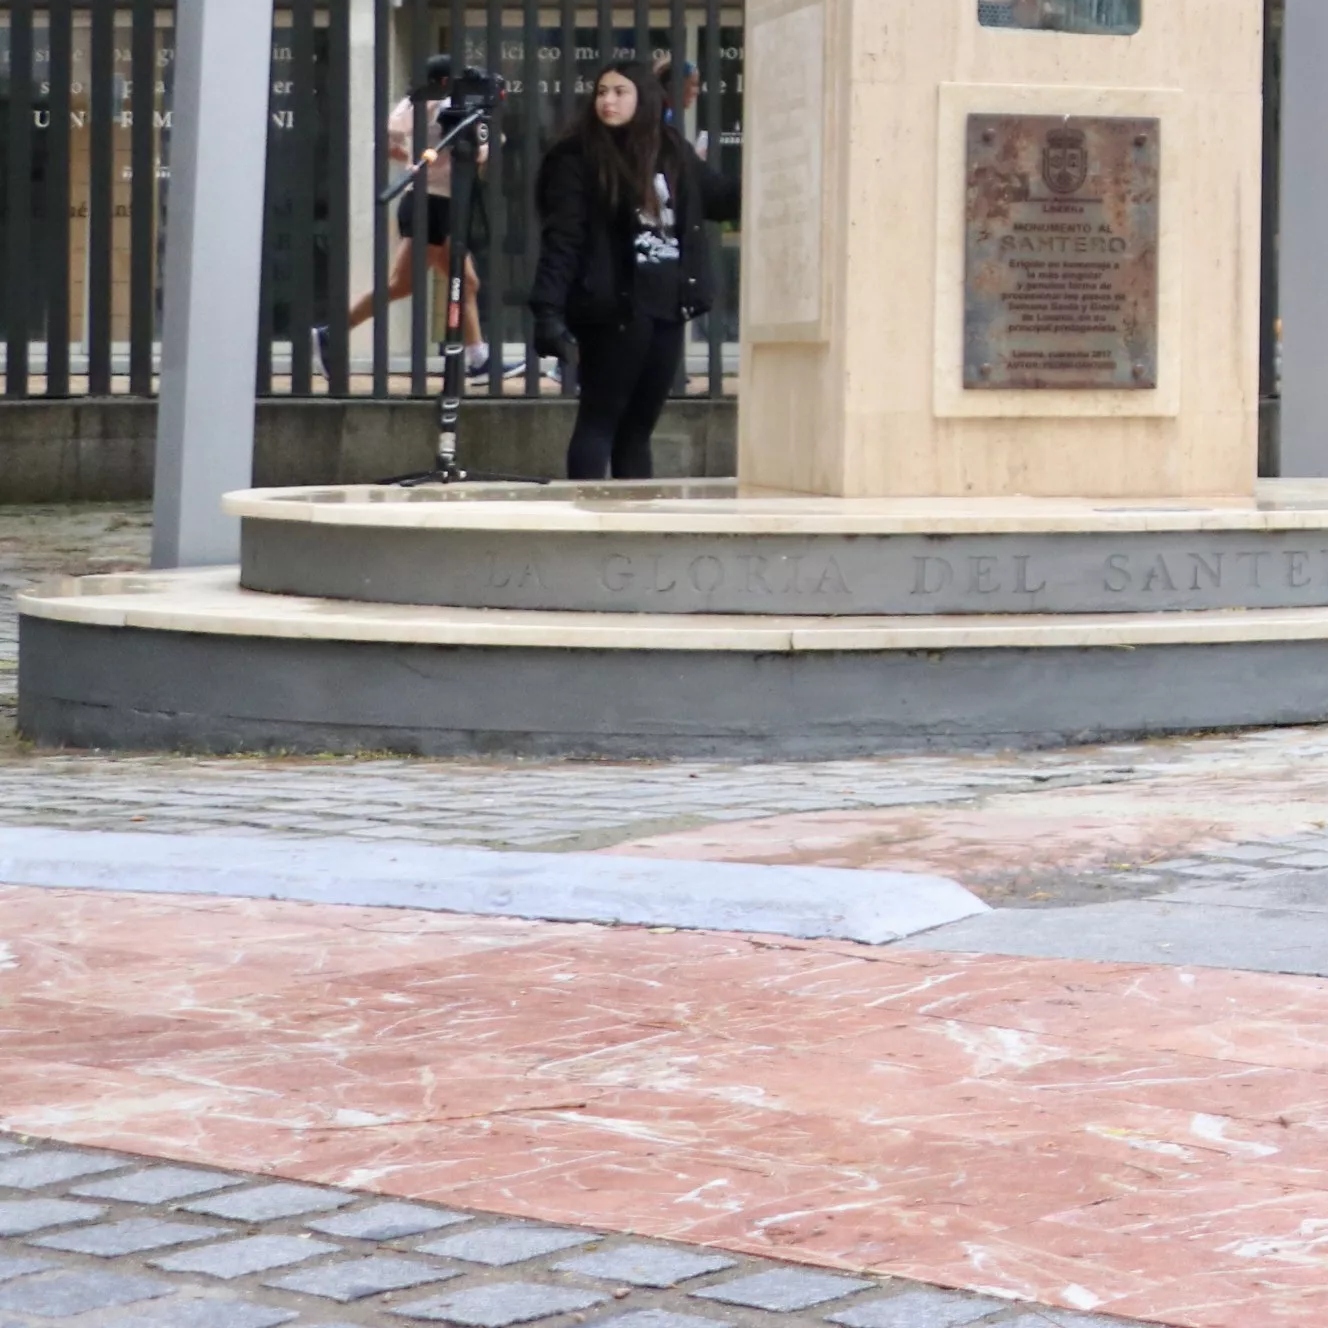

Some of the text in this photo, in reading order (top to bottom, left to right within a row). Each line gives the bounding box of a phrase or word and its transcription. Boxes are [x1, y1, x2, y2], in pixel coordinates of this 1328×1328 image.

[1013, 222, 1113, 234] MONUMENTO AL
[999, 234, 1128, 254] SANTERO
[484, 550, 550, 591] LA
[600, 552, 854, 597] GLORIA
[908, 554, 1048, 597] DEL
